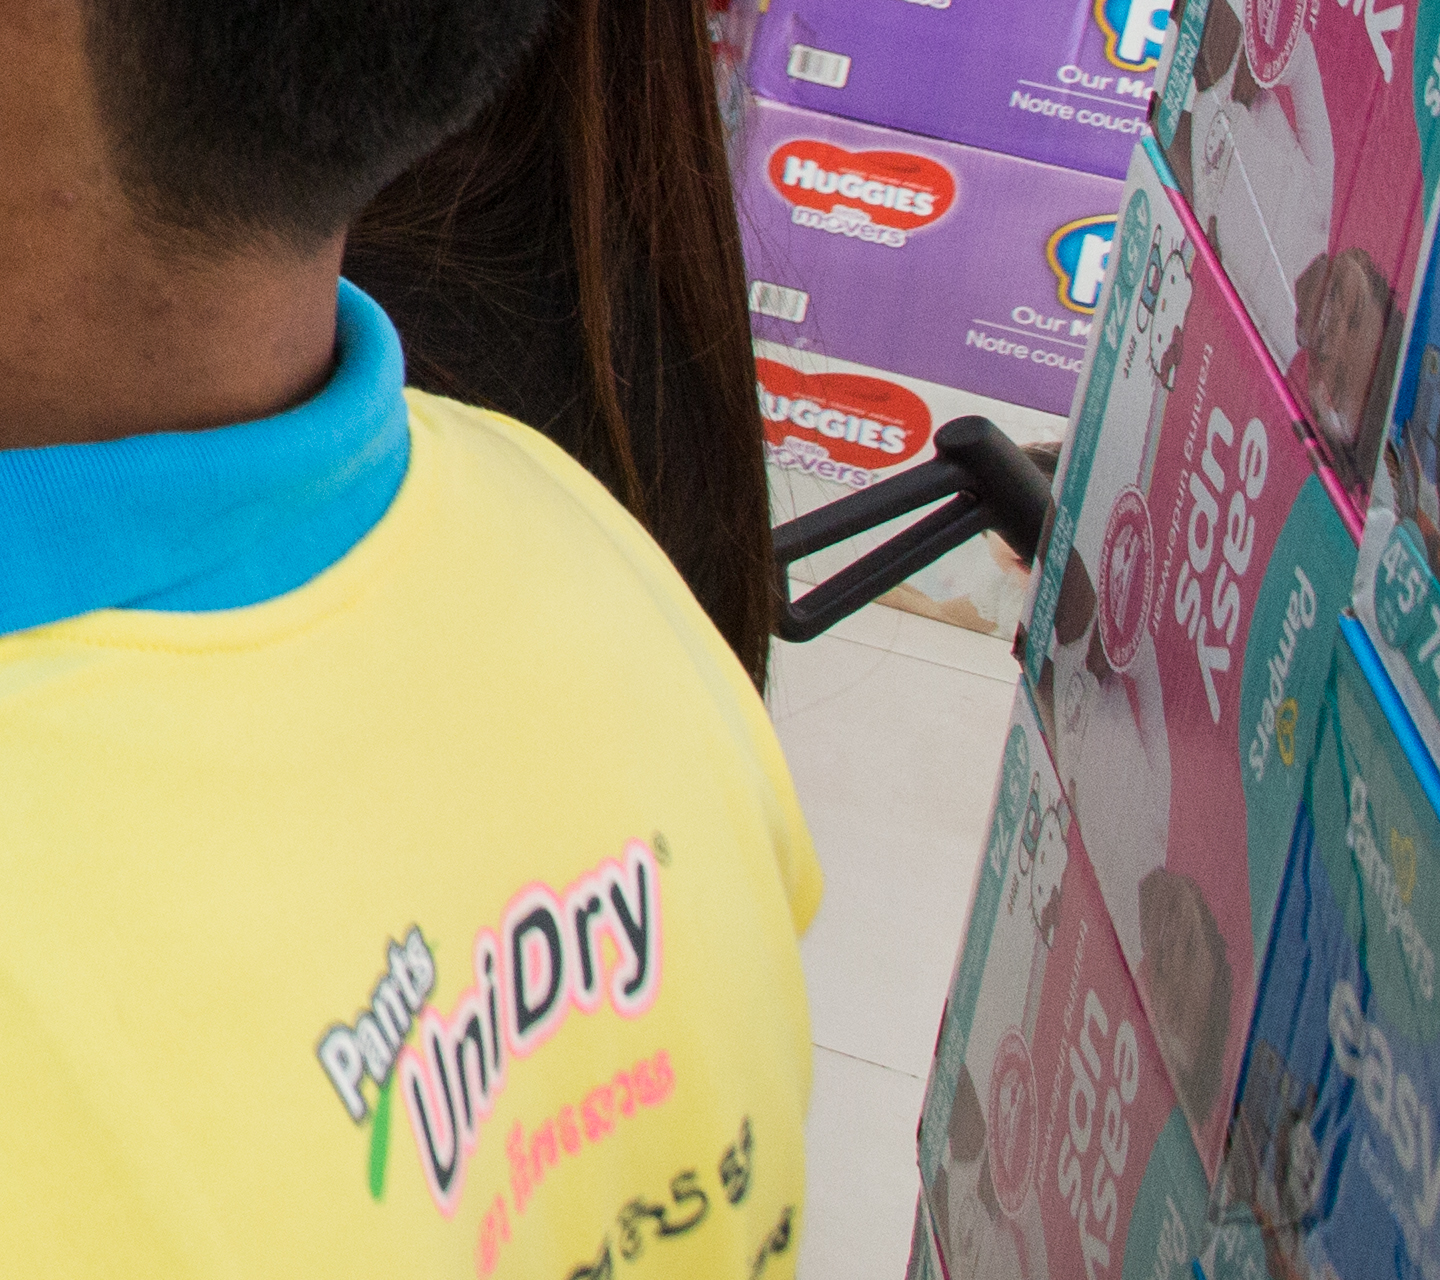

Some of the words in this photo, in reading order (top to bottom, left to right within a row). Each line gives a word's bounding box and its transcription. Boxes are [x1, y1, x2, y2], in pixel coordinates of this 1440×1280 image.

[1009, 90, 1074, 123] Notre
[1076, 106, 1151, 138] couch
[1057, 62, 1112, 91] Our
[783, 155, 938, 217] HUGGIES
[792, 206, 908, 249] movers
[965, 329, 1029, 361] Notre
[1010, 304, 1066, 333] Our
[757, 383, 910, 456] UGGIES
[1183, 342, 1214, 460] training
[1150, 469, 1191, 637] underwear
[1173, 406, 1235, 641] ups
[1196, 417, 1271, 724] easy
[1247, 565, 1317, 782] Pampers
[1345, 775, 1438, 999] Pampers
[315, 922, 438, 1126] Pants
[406, 855, 655, 1200] UniDry
[1057, 988, 1115, 1197] ups
